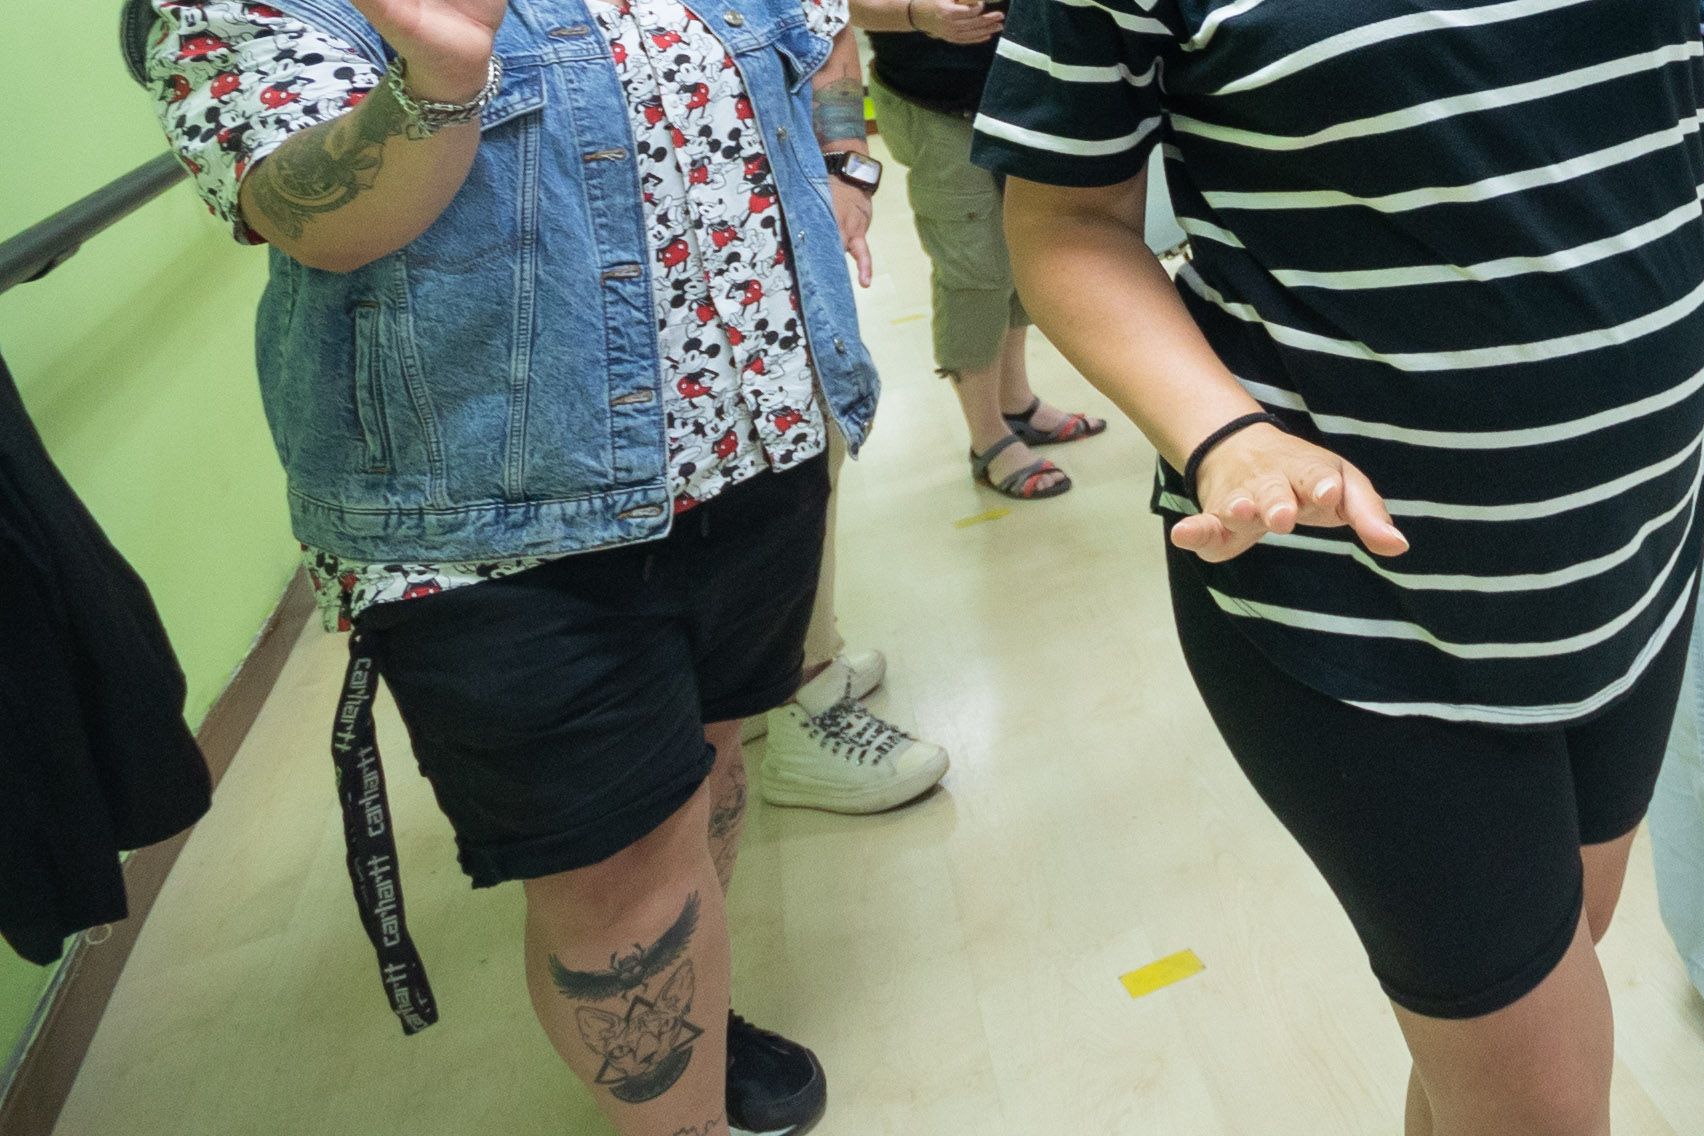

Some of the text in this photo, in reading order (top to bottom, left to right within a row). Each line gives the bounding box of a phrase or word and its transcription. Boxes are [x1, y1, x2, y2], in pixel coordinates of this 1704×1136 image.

[335, 657, 372, 752] carhartt
[356, 746, 385, 838] carhartt
[368, 855, 400, 947] carhartt
